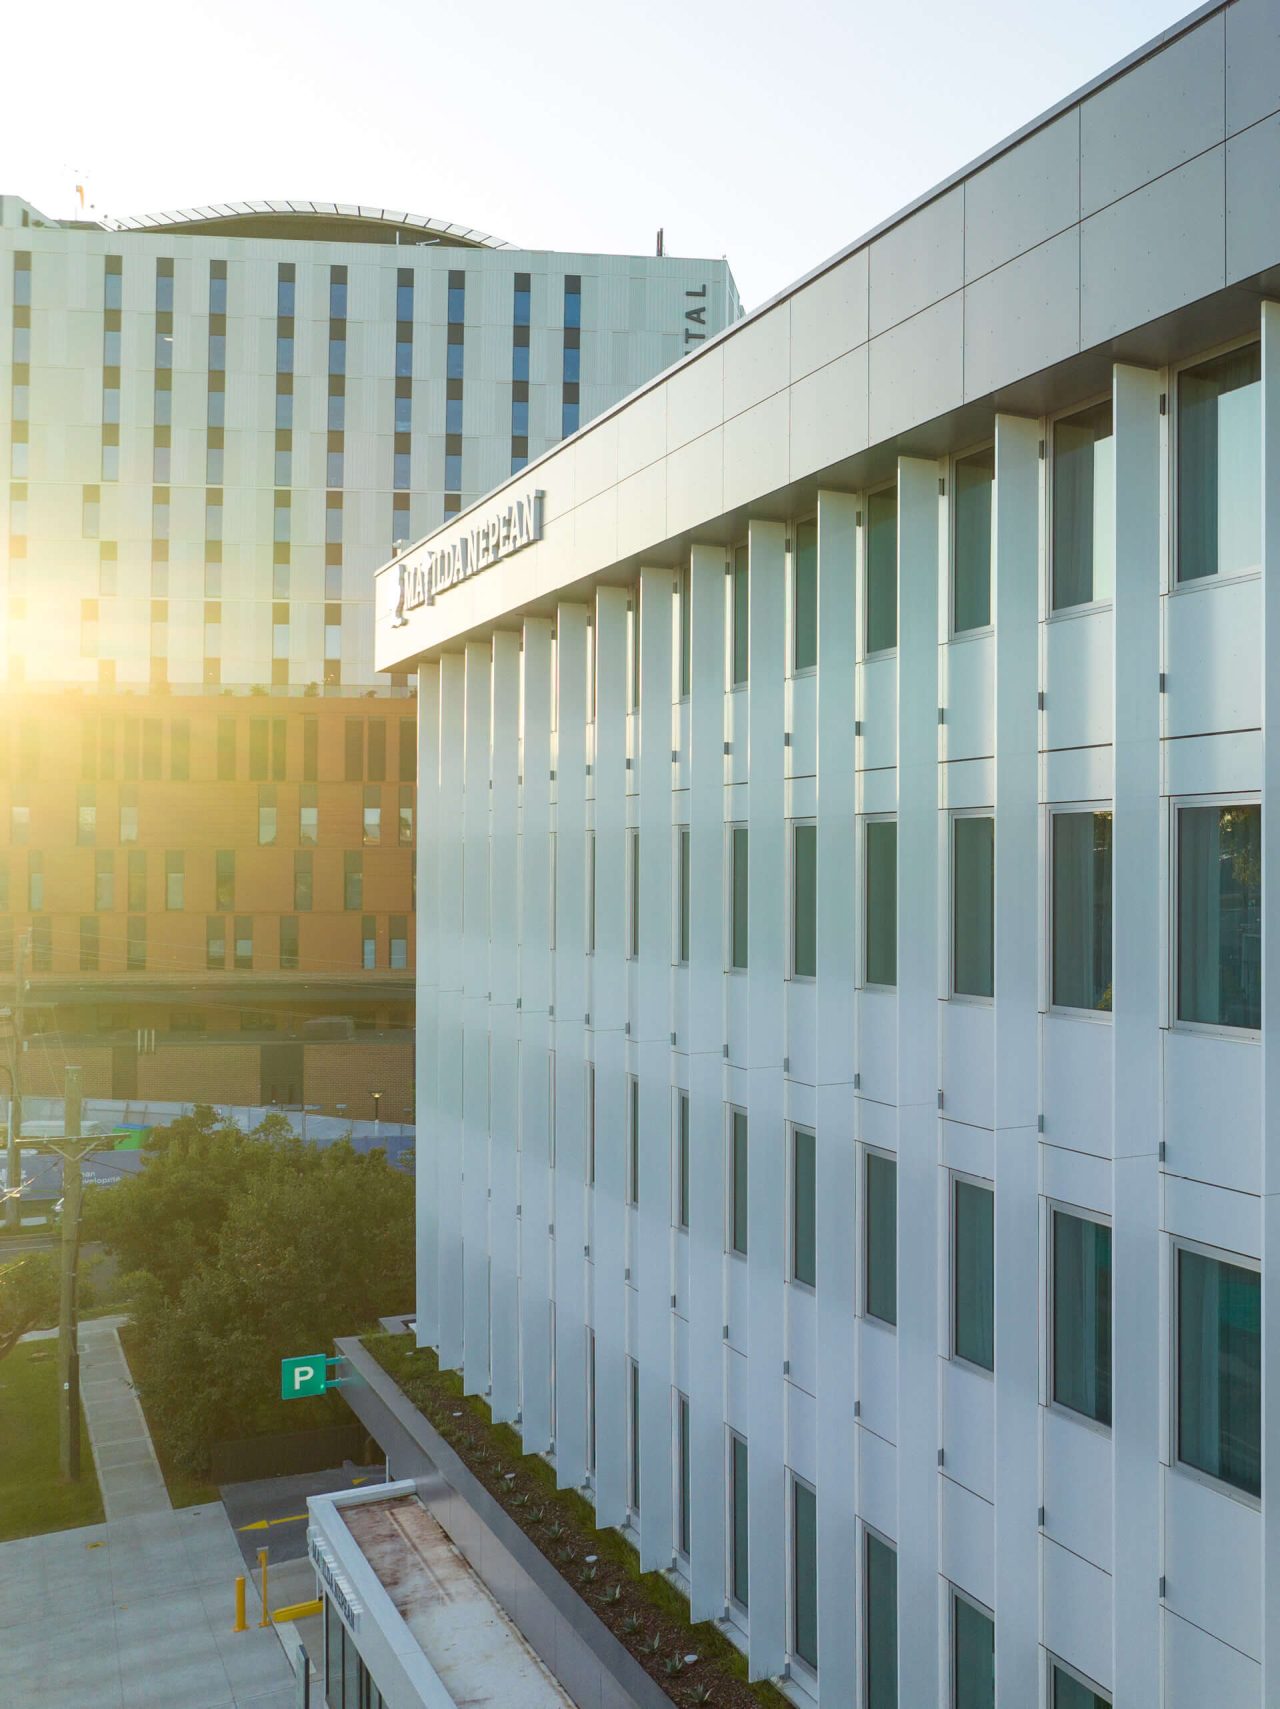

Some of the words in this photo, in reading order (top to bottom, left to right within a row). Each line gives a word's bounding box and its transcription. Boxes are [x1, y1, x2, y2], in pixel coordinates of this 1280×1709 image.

[684, 284, 706, 355] TAL
[466, 489, 545, 577] NEPEAN
[294, 1366, 314, 1391] P
